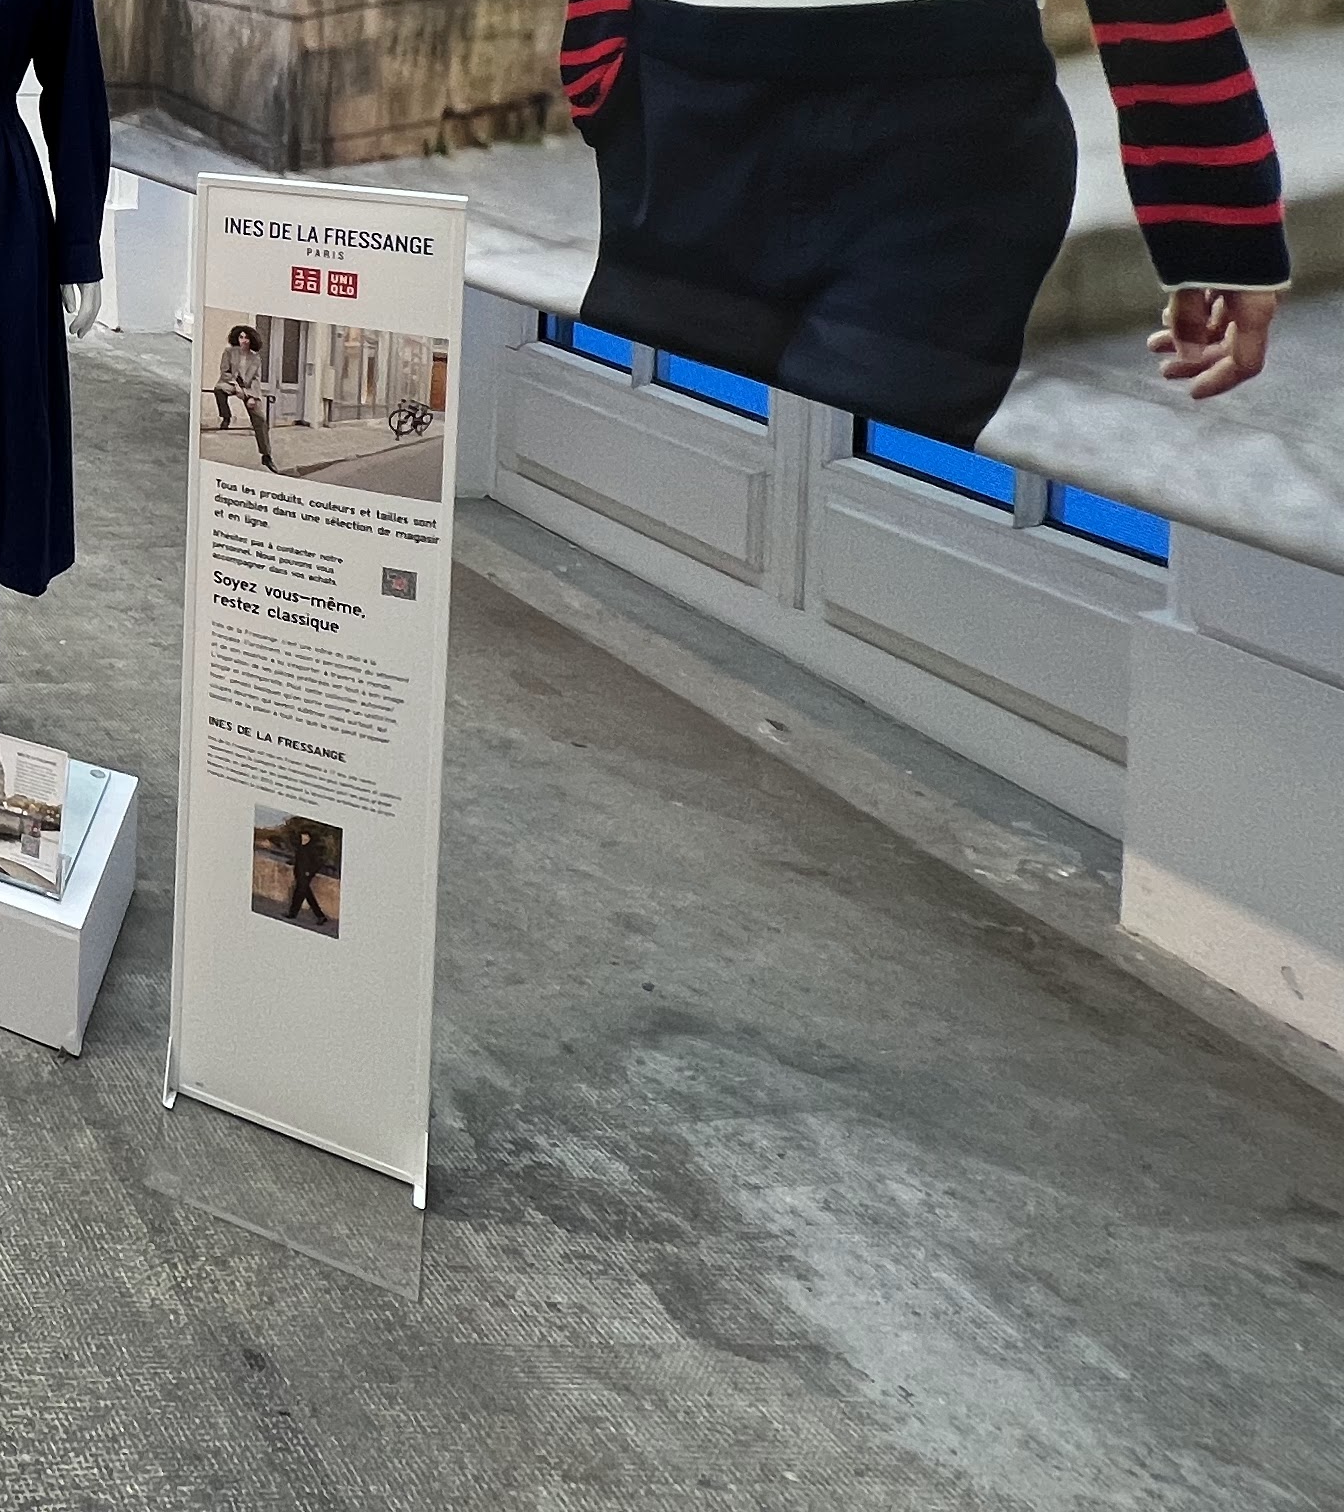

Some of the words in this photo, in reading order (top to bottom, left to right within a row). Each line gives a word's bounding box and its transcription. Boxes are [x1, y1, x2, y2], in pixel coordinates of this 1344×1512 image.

[224, 216, 264, 239] INES
[268, 220, 292, 241] DE
[296, 224, 318, 244] LA
[323, 227, 435, 257] FRESSANGE
[306, 248, 345, 261] PARIS
[214, 493, 268, 513] disponibles
[272, 506, 297, 519] dans
[300, 512, 321, 524] une
[325, 516, 373, 533] sélection
[377, 526, 391, 537] de
[215, 478, 238, 492] Tous
[241, 484, 256, 496] les
[308, 498, 356, 516] couleurs
[360, 507, 371, 518] et
[376, 509, 409, 525] tailles
[413, 517, 437, 530] sont
[214, 509, 224, 518] et
[228, 512, 241, 522] en
[244, 515, 269, 529] ligne.
[255, 550, 276, 562] Nous
[279, 556, 313, 571] pouvons
[316, 564, 335, 575] vous
[276, 543, 316, 559] contacter
[319, 551, 344, 564] notre
[213, 570, 257, 594] Soyez
[268, 564, 288, 576] dans
[213, 592, 260, 616] restez
[267, 606, 340, 633] classique
[209, 716, 233, 732] INES
[237, 725, 252, 737] DE
[256, 730, 273, 744] LA
[277, 736, 347, 763] FRESSANGE
